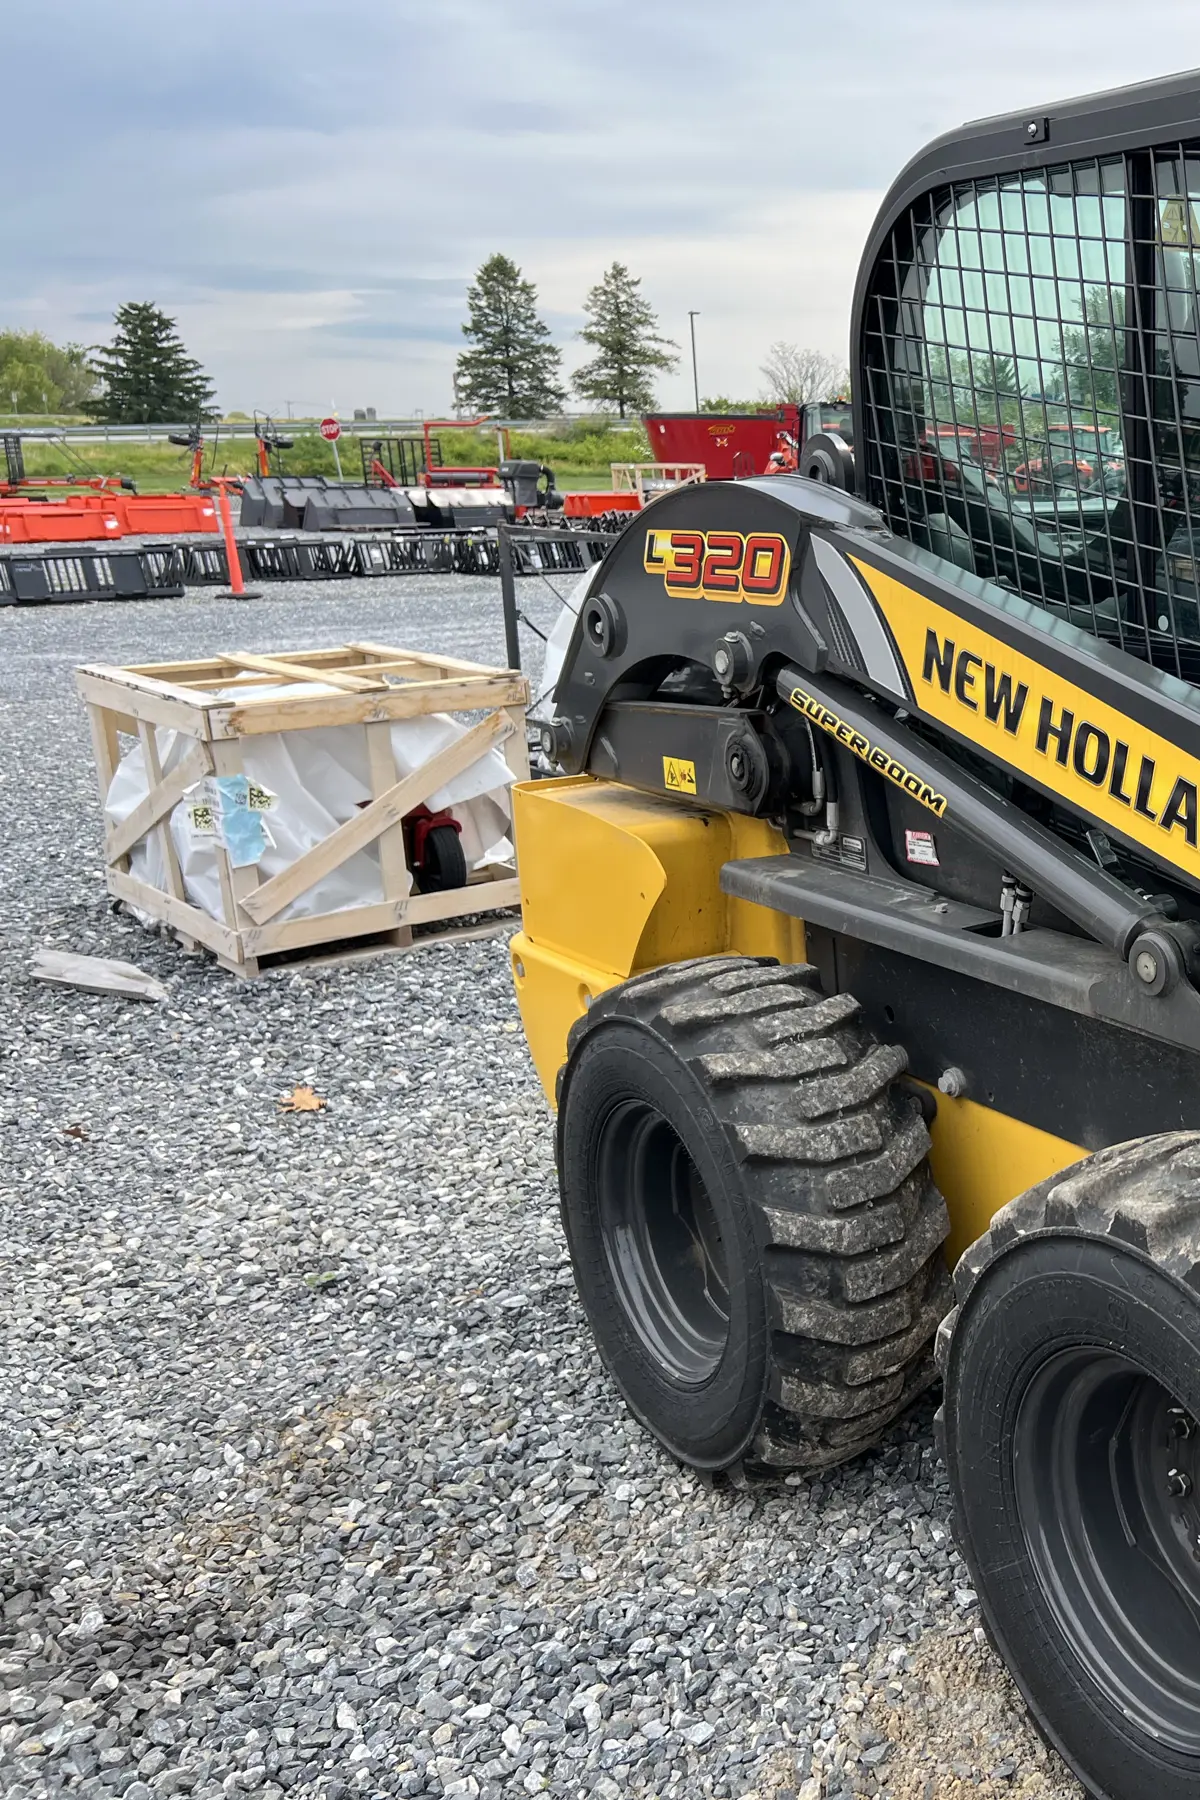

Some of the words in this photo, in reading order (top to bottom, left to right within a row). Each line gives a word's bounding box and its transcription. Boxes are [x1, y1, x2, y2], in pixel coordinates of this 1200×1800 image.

[321, 424, 339, 435] STOP
[644, 529, 791, 606] L320
[921, 626, 1029, 736] NEW
[791, 688, 870, 761] SUPER
[868, 747, 948, 818] BOOM
